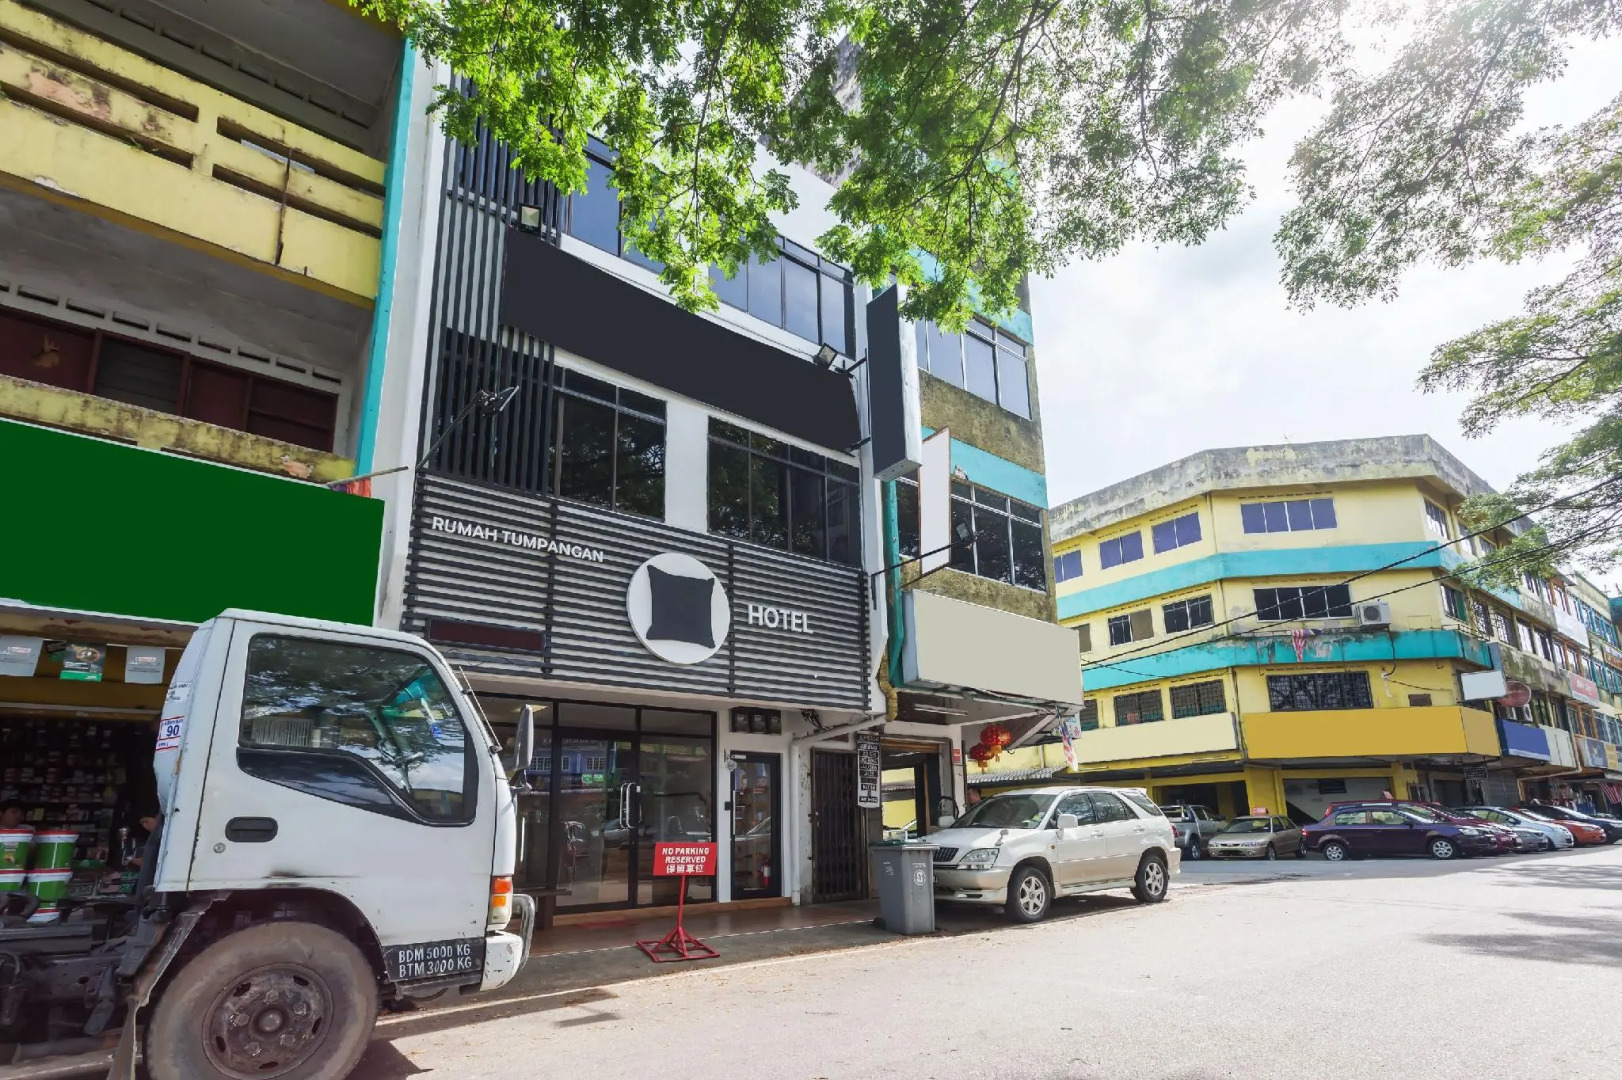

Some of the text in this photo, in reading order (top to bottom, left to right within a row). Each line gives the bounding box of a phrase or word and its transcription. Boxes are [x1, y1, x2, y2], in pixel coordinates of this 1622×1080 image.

[432, 516, 604, 562] RUMAH TUMPANGAN
[748, 604, 814, 634] HOTEL
[166, 725, 180, 737] 90
[662, 847, 710, 855] NO PARKING
[665, 856, 706, 864] RESERVED
[399, 943, 471, 963] BDM 5000 KG
[399, 956, 472, 977] BTM 3000 KG
